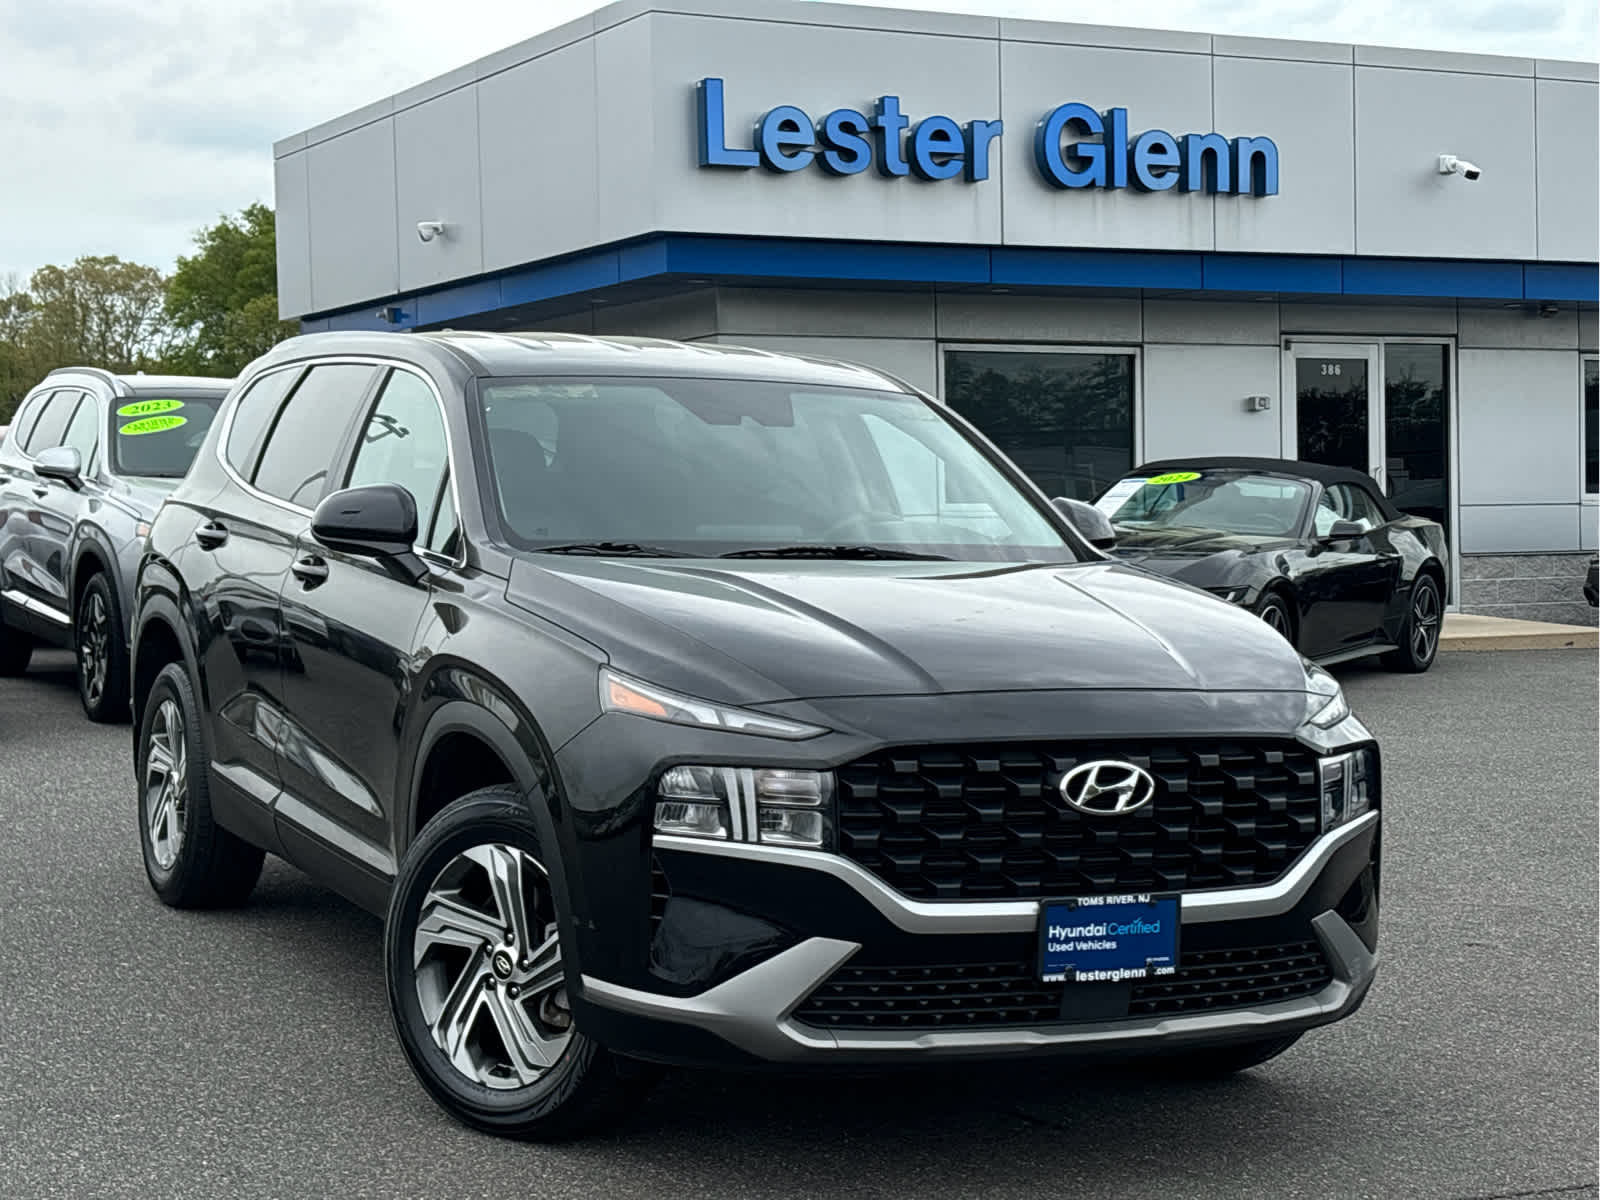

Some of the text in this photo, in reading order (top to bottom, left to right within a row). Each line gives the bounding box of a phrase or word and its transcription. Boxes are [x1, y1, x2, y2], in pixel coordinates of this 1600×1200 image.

[696, 77, 1279, 198] Lester Glenn
[1320, 363, 1341, 376] 386
[1077, 896, 1105, 907] TOMS
[1138, 893, 1151, 904] NJ
[1048, 918, 1161, 941] Hyundai Certified
[1047, 939, 1118, 953] Used Vehicles
[1075, 967, 1147, 982] lesterglenn
